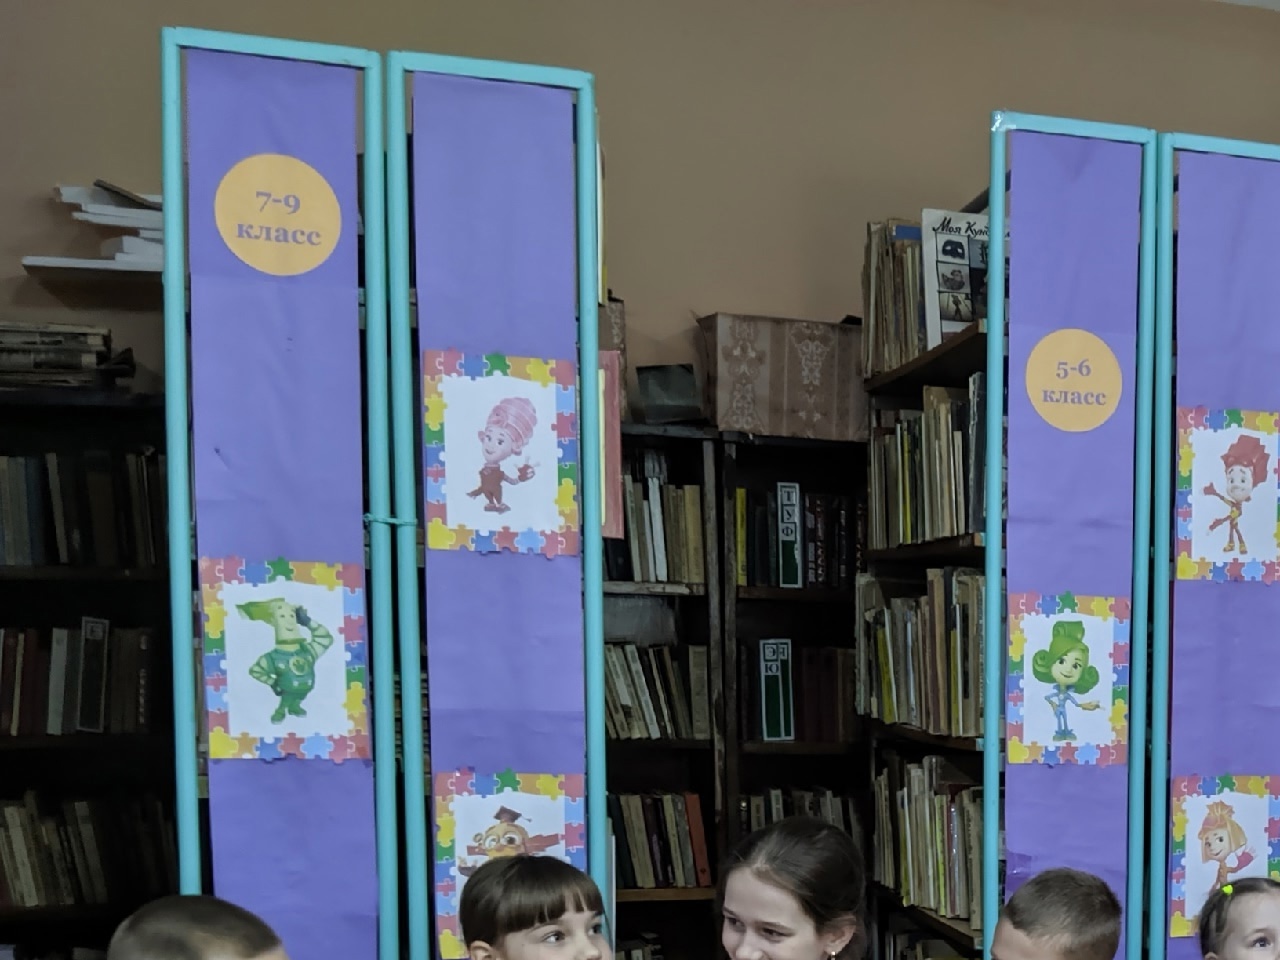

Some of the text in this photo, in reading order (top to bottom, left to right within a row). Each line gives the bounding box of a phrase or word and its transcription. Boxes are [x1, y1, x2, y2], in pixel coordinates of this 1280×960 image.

[255, 191, 301, 215] 7-9
[236, 223, 322, 246] класс
[1055, 358, 1092, 380] 5-6
[1042, 389, 1107, 406] класс
[782, 526, 794, 537] Ф
